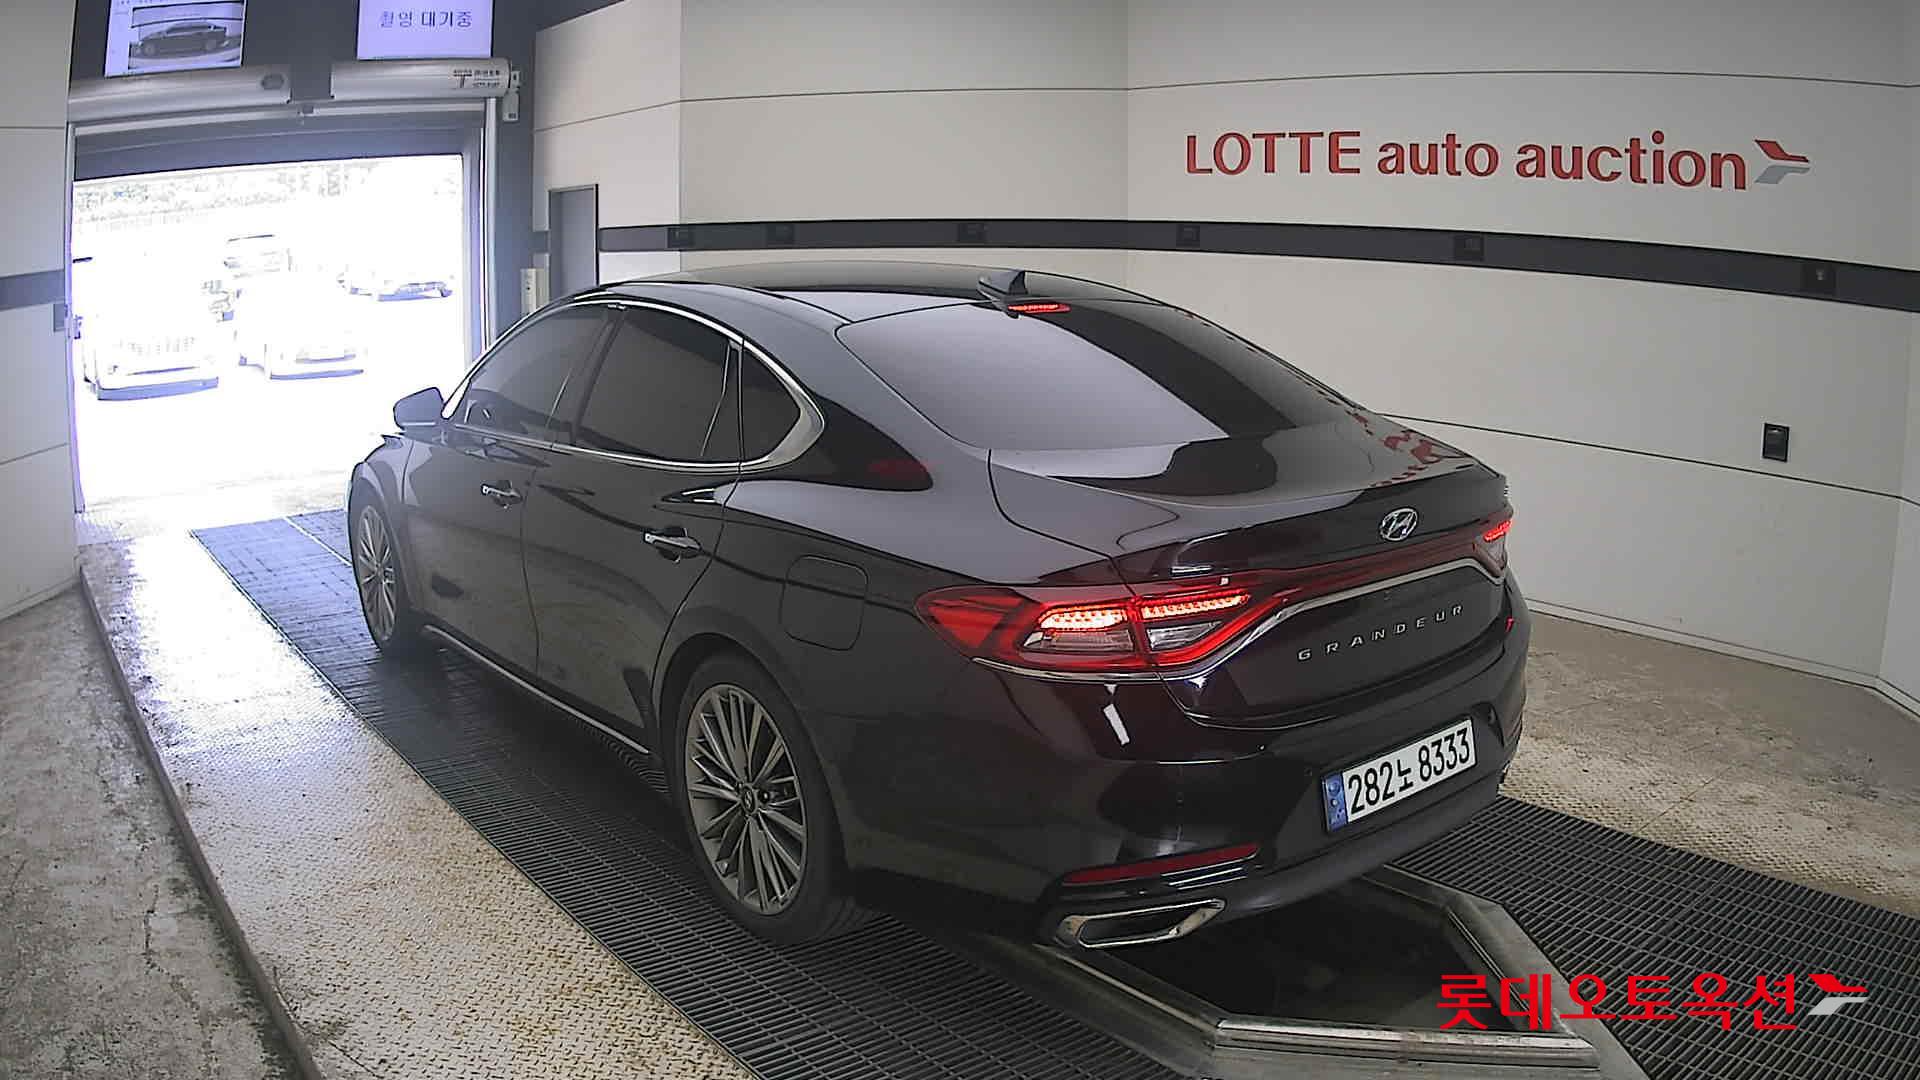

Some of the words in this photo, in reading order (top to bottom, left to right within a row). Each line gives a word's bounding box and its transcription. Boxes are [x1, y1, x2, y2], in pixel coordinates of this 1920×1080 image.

[421, 10, 472, 28] 대기중
[1185, 130, 1361, 175] LOTTE
[1377, 133, 1499, 177] auto
[1515, 130, 1746, 190] auction
[1297, 604, 1463, 661] GRANDEUR
[1347, 757, 1414, 815] 282노
[1417, 726, 1470, 782] 8333
